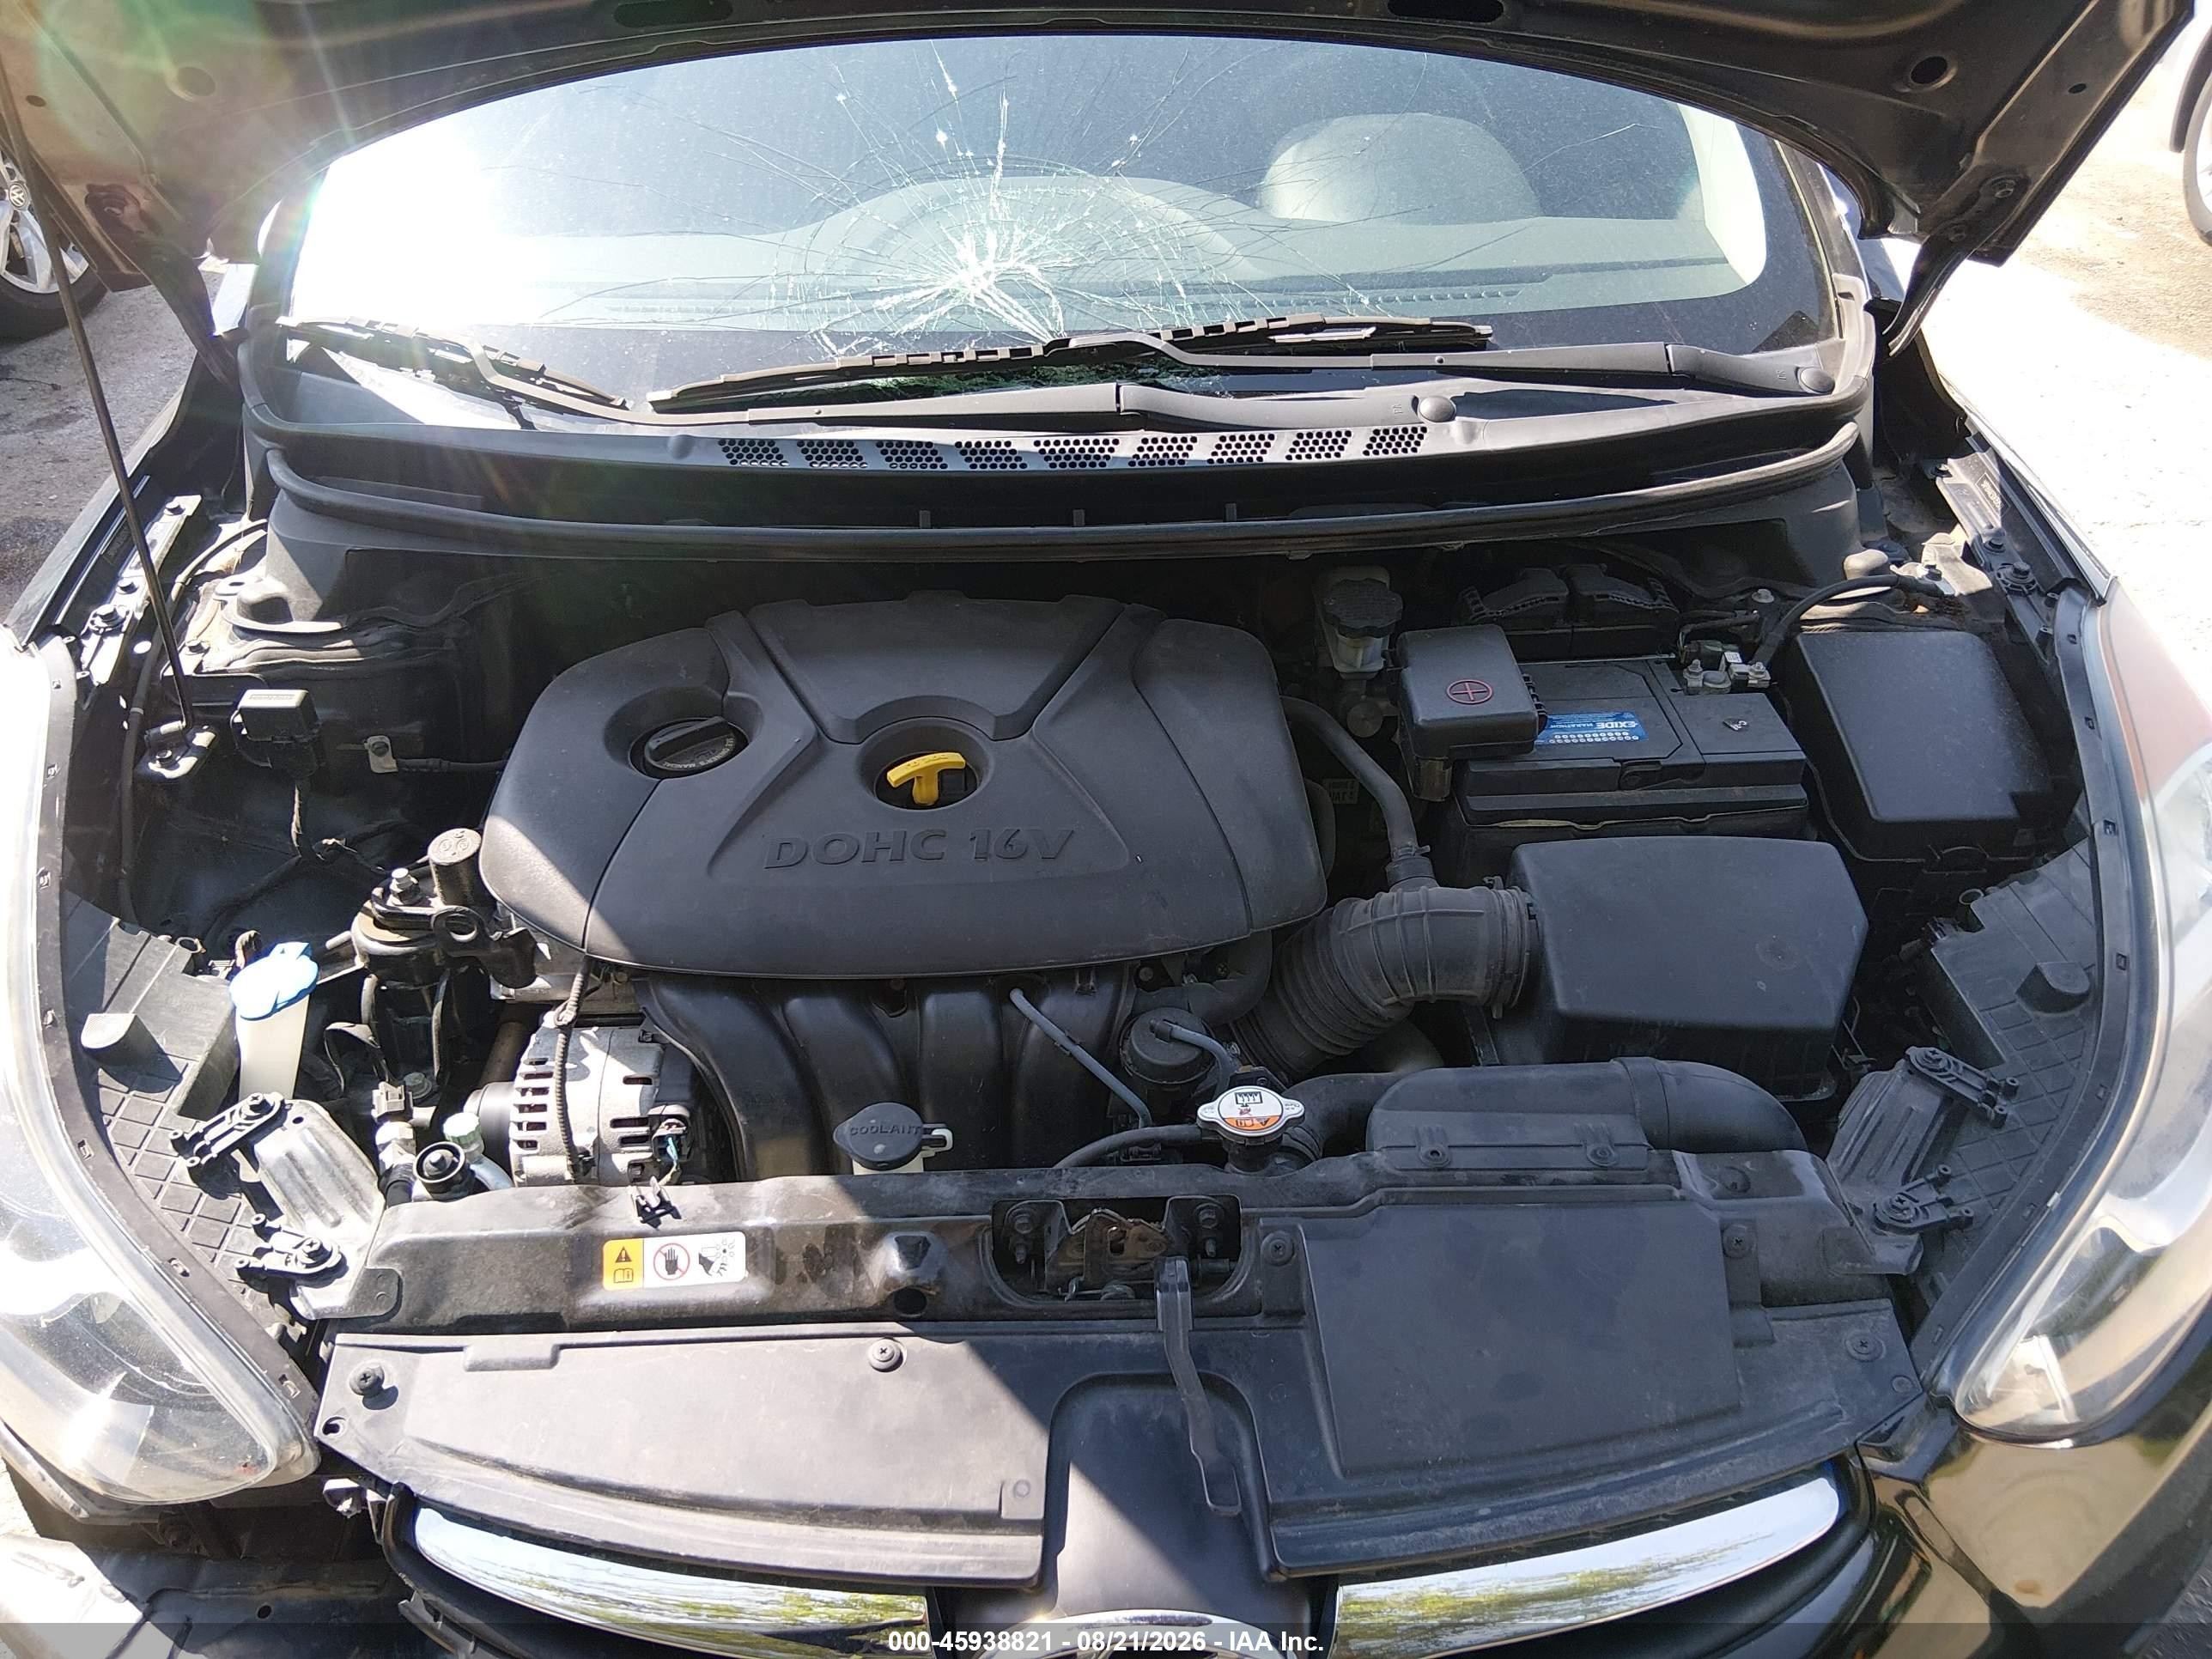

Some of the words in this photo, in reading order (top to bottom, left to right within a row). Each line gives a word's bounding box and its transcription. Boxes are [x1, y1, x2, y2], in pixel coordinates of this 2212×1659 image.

[1596, 720, 1636, 729] EXIDE
[661, 761, 696, 769] MANUAL
[763, 829, 946, 870] DOHC
[969, 828, 1075, 860] 16V
[849, 1124, 921, 1136] COOLANT
